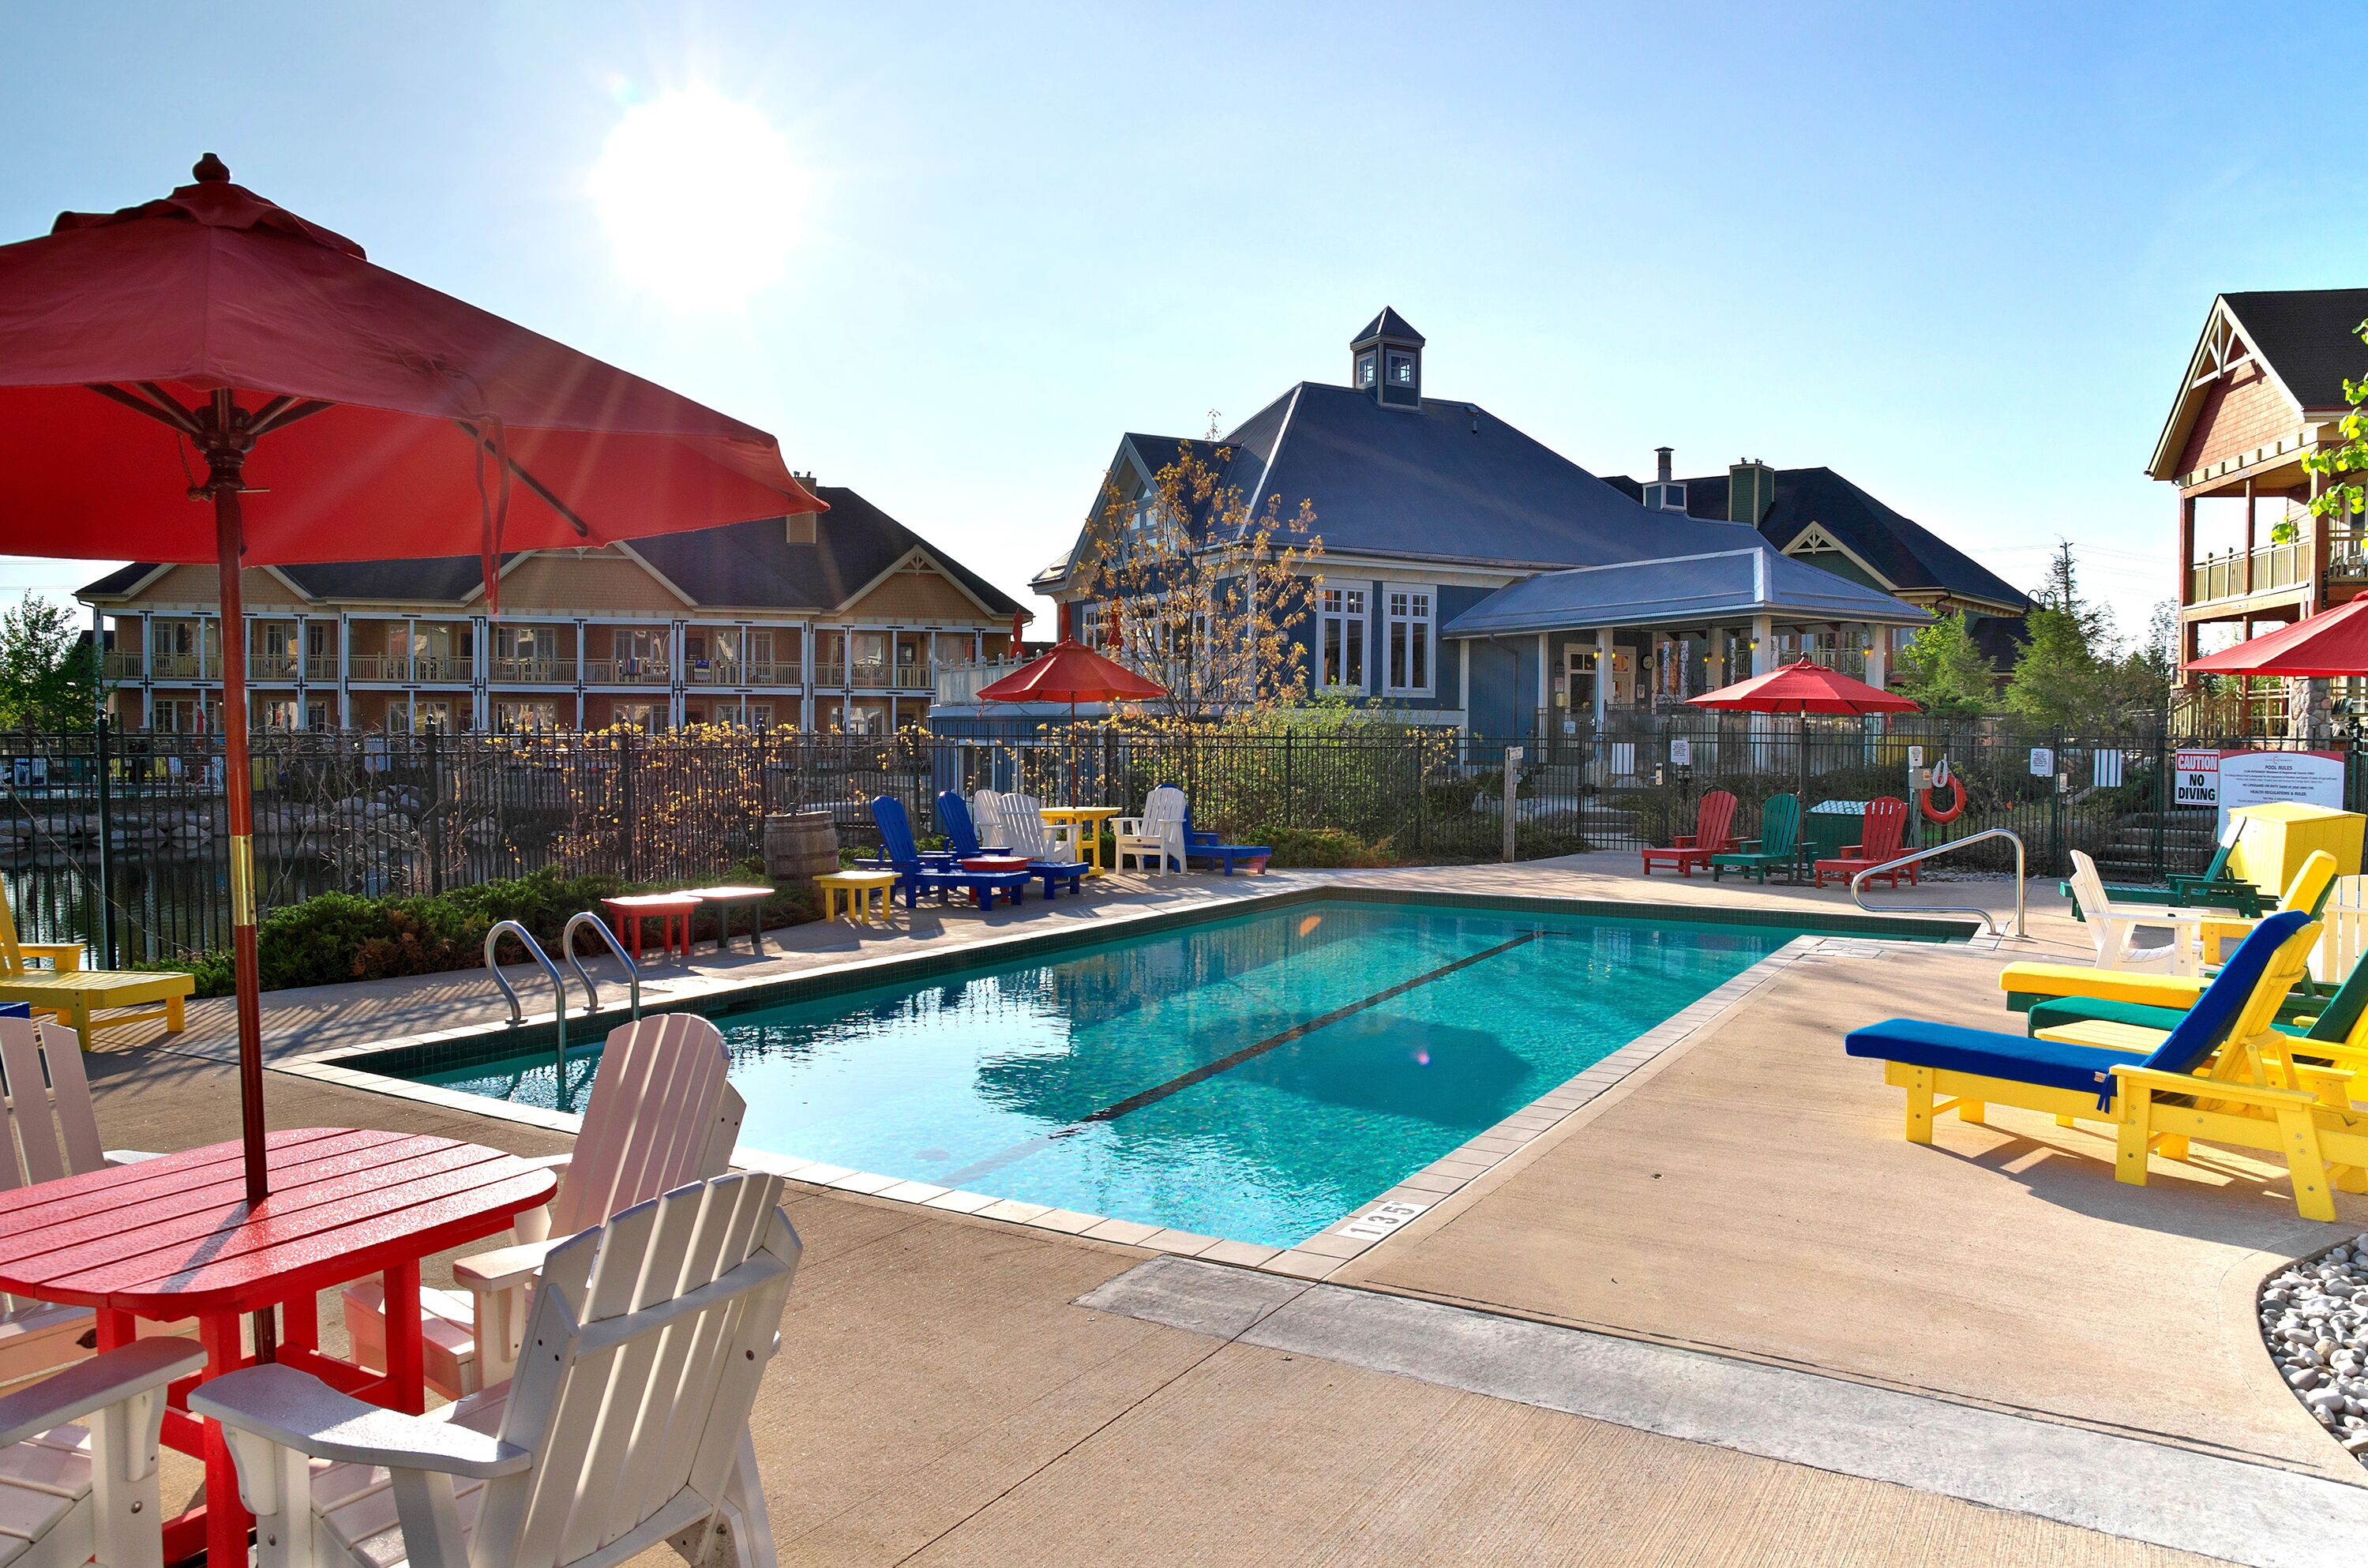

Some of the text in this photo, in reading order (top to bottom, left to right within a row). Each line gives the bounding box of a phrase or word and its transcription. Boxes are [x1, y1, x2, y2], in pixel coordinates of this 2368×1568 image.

[2178, 756, 2217, 770] CAUTION
[2190, 775, 2205, 786] NO
[2178, 787, 2216, 801] DIVING
